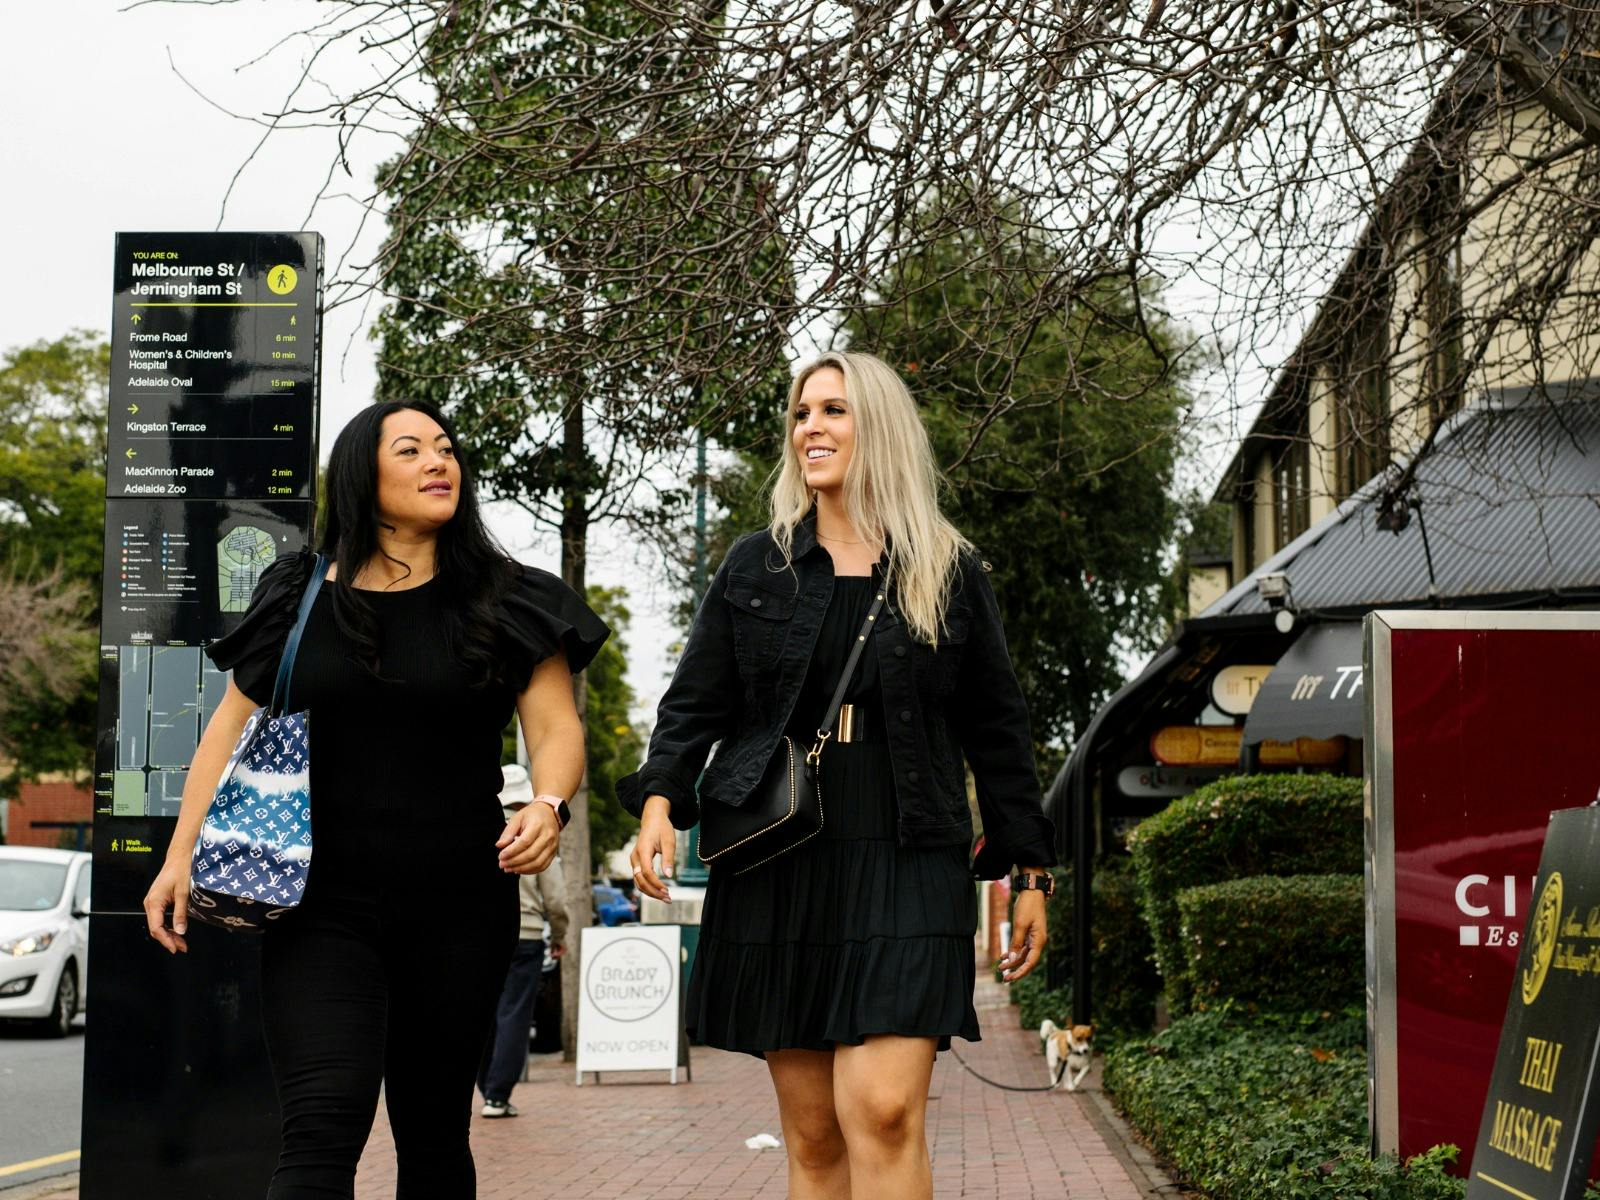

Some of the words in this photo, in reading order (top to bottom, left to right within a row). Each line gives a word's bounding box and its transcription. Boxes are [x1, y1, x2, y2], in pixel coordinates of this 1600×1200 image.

[133, 252, 149, 260] YOU
[150, 252, 165, 260] ARE
[132, 263, 213, 277] Melbourne
[217, 263, 235, 277] St
[237, 263, 245, 277] /
[131, 282, 222, 297] Jerningham
[225, 282, 242, 295] St
[129, 332, 160, 342] Frome
[162, 332, 188, 342] Road
[275, 334, 281, 342] 6
[282, 334, 296, 342] min
[129, 350, 174, 359] Women's
[176, 350, 183, 359] &
[184, 350, 232, 359] Children's
[129, 360, 168, 371] Hospital
[128, 377, 169, 387] Adelaide
[171, 377, 193, 387] Oval
[270, 379, 280, 387] 15
[281, 379, 295, 387] min
[126, 422, 168, 434] Kingston
[170, 422, 207, 432] Terrace
[273, 424, 279, 432] 4
[280, 424, 294, 432] min
[125, 467, 179, 476] MacKinnon
[180, 467, 214, 476] Parade
[271, 469, 278, 477] 2
[278, 469, 293, 477] min
[124, 484, 165, 494] Adelaide
[167, 484, 187, 494] Zoo
[267, 486, 277, 494] 12
[278, 486, 292, 494] min
[1455, 874, 1536, 917] CI
[601, 966, 658, 984] BRADY
[594, 983, 665, 1000] BRUNCH
[586, 1041, 624, 1054] NOW
[627, 1039, 669, 1053] OPEN
[1519, 1036, 1563, 1094] THAI
[1488, 1100, 1563, 1172] MASSAGE
